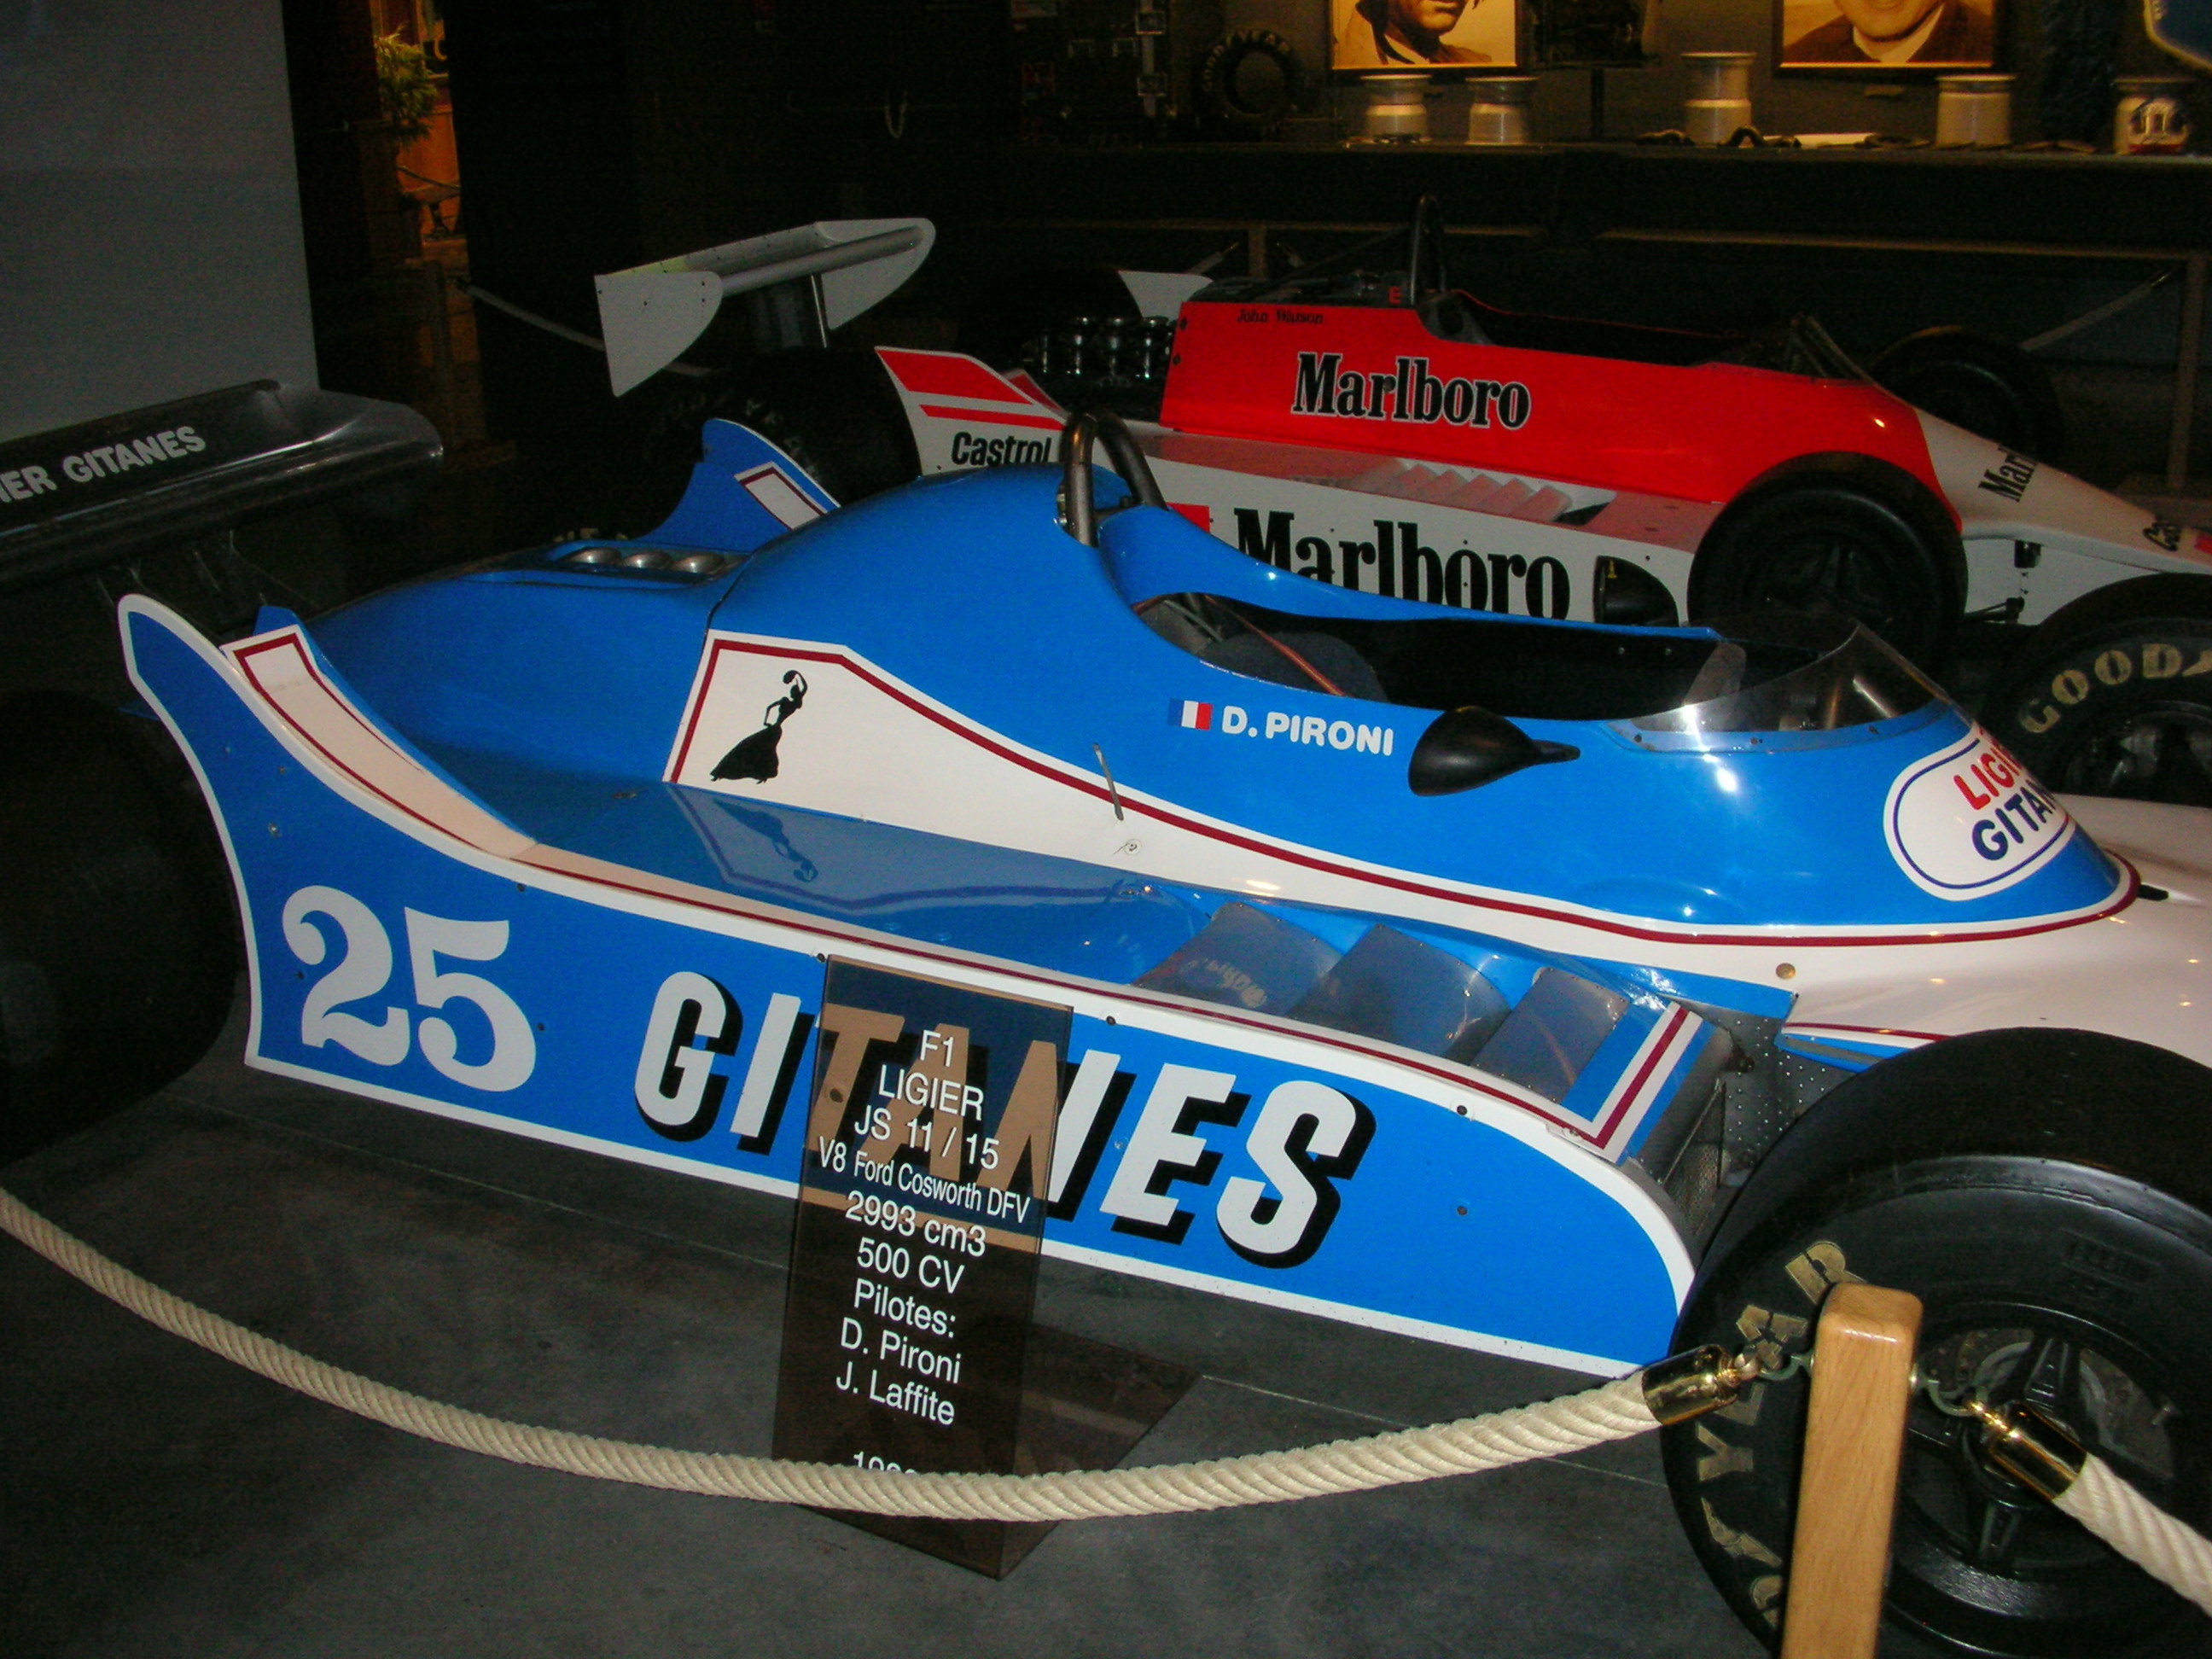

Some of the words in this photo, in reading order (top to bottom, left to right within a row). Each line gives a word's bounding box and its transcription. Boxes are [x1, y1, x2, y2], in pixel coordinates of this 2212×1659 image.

[1237, 308, 1269, 323] John
[1276, 309, 1324, 324] Watson
[1291, 351, 1531, 430] Marlboro
[61, 426, 207, 483] GITANES
[952, 432, 1051, 468] Castrol
[1234, 508, 1570, 620] Marlboro
[1221, 705, 1258, 737] D.
[1266, 711, 1394, 756] PIRONI
[282, 884, 537, 1092] 25
[919, 1029, 953, 1067] F1
[634, 970, 1372, 1269] GITANES
[878, 1064, 984, 1121] LIGIER
[854, 1105, 892, 1140] JS
[906, 1118, 933, 1152] 11
[941, 1126, 958, 1157] /
[966, 1133, 999, 1170] 15
[818, 1136, 847, 1173] V8
[854, 1150, 894, 1186] Ford
[898, 1162, 981, 1212] Cosworth
[987, 1187, 1031, 1224] DFV
[845, 1190, 917, 1237] 2993
[924, 1219, 987, 1257] cm3
[857, 1237, 910, 1278] 500
[918, 1254, 965, 1294] CV
[854, 1278, 956, 1338] Pilotes:
[841, 1317, 868, 1354] D.
[880, 1330, 962, 1384] Pironi
[835, 1361, 859, 1394] J.
[870, 1369, 955, 1425] Laffite
